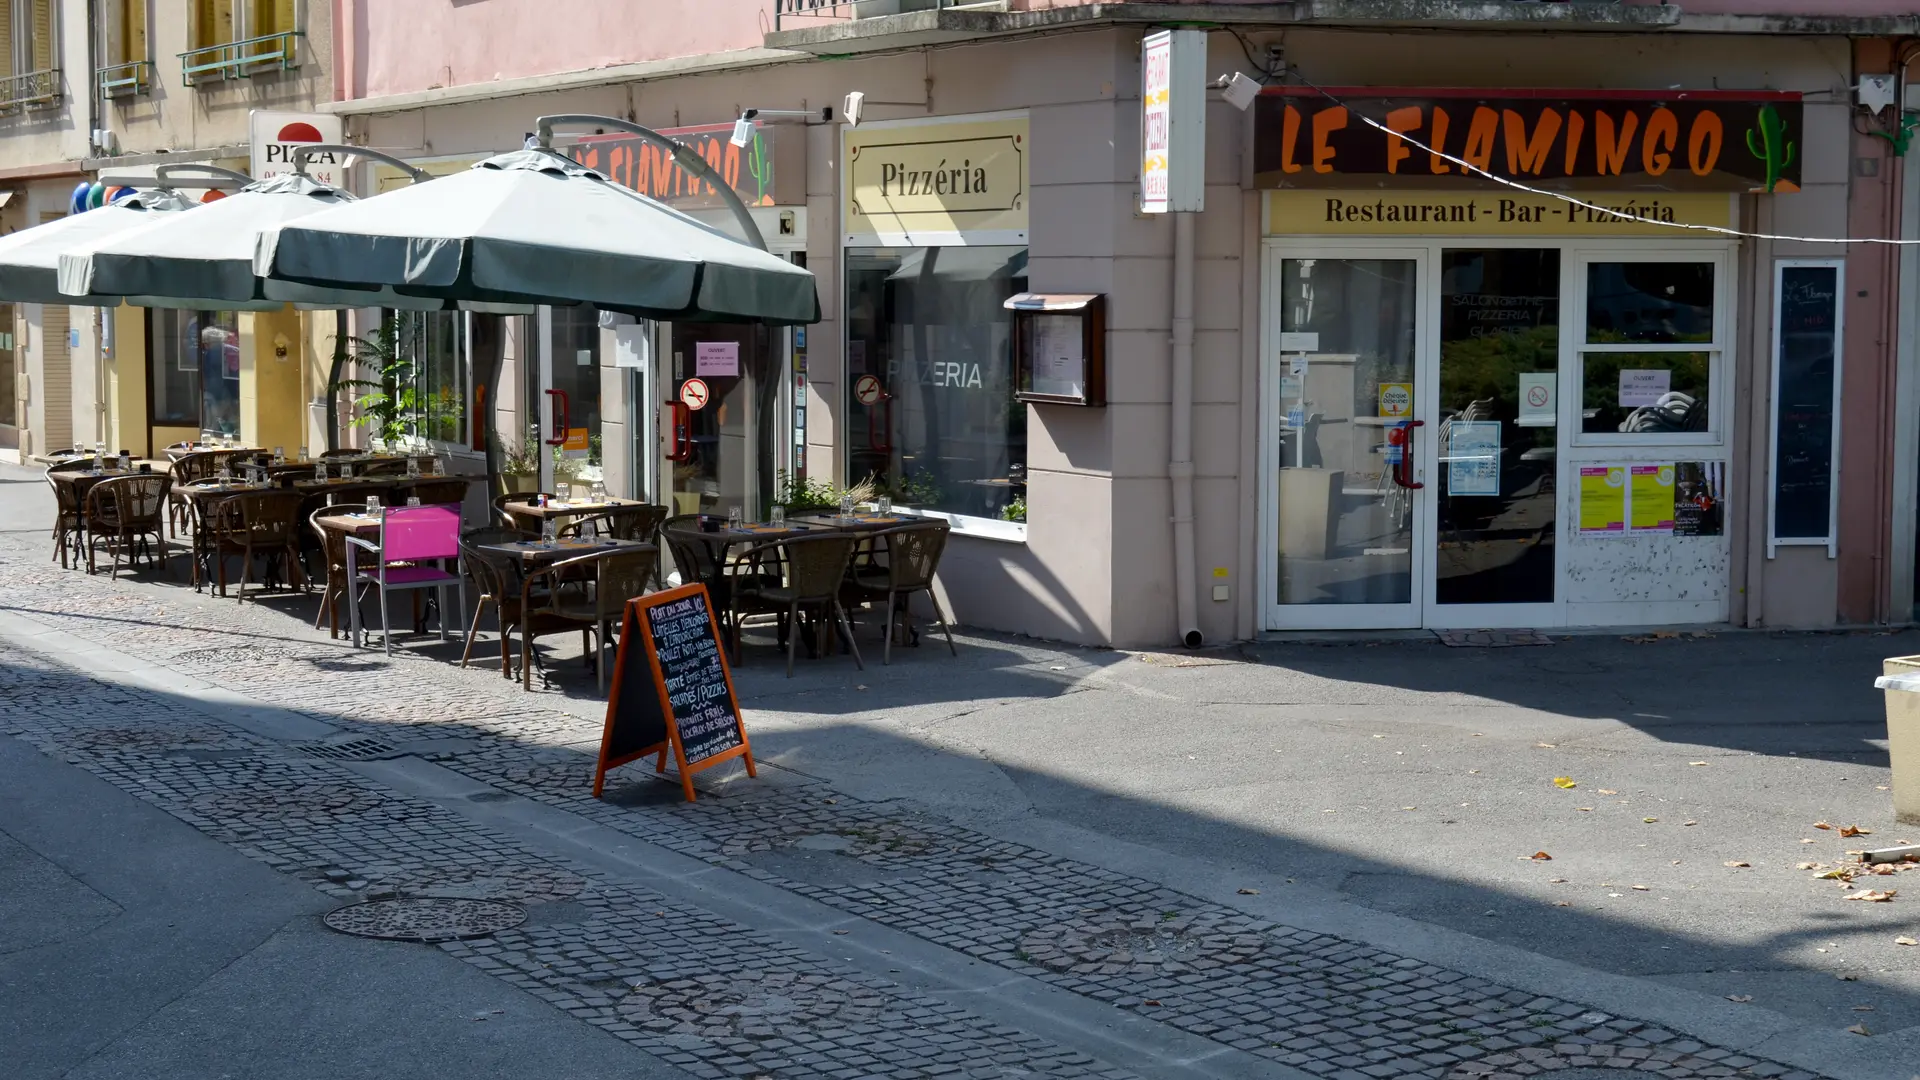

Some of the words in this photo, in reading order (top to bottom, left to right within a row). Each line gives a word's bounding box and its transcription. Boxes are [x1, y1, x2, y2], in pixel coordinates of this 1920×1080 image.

[1282, 105, 1348, 174] LE
[1386, 105, 1723, 177] FLAMINGO
[881, 158, 987, 197] Pizzéria
[1326, 198, 1477, 222] Restaurant
[1498, 199, 1547, 223] Bar
[1567, 199, 1676, 224] Pizzéria
[1467, 309, 1531, 321] PIZZERIA
[667, 604, 676, 616] DU
[676, 599, 692, 612] JOUR
